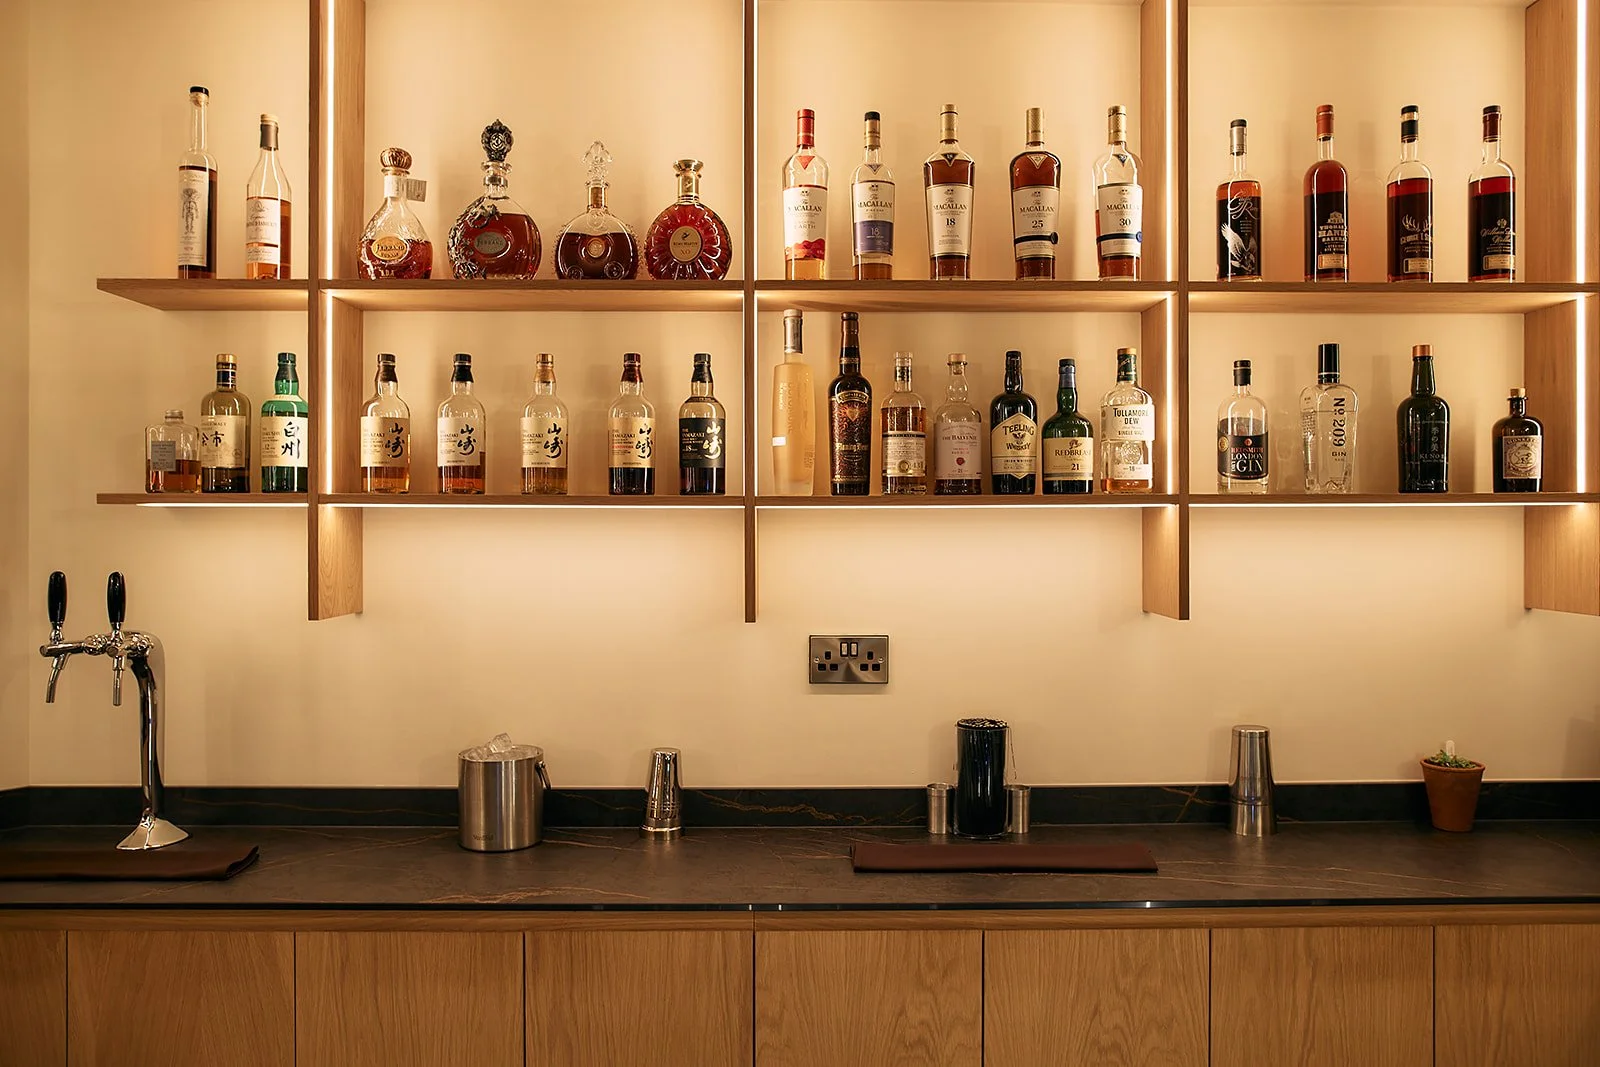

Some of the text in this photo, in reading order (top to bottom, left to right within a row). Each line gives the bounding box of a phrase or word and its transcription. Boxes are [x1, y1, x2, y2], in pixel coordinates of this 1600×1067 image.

[946, 218, 956, 226] 18
[1031, 220, 1044, 228] 25
[1119, 218, 1131, 226] 30
[871, 228, 880, 236] 18
[1113, 408, 1149, 417] TULLAMORE
[1002, 423, 1035, 436] TEELING
[1333, 419, 1346, 447] 209
[281, 421, 301, 460] 白州
[385, 422, 405, 459] 山崎
[457, 424, 477, 456] 山崎
[543, 422, 564, 459] 山崎
[635, 423, 653, 459] 山崎
[702, 421, 723, 459] 山崎
[1231, 452, 1263, 460] LONDON
[1071, 463, 1080, 471] 21
[1236, 460, 1264, 472] GIN
